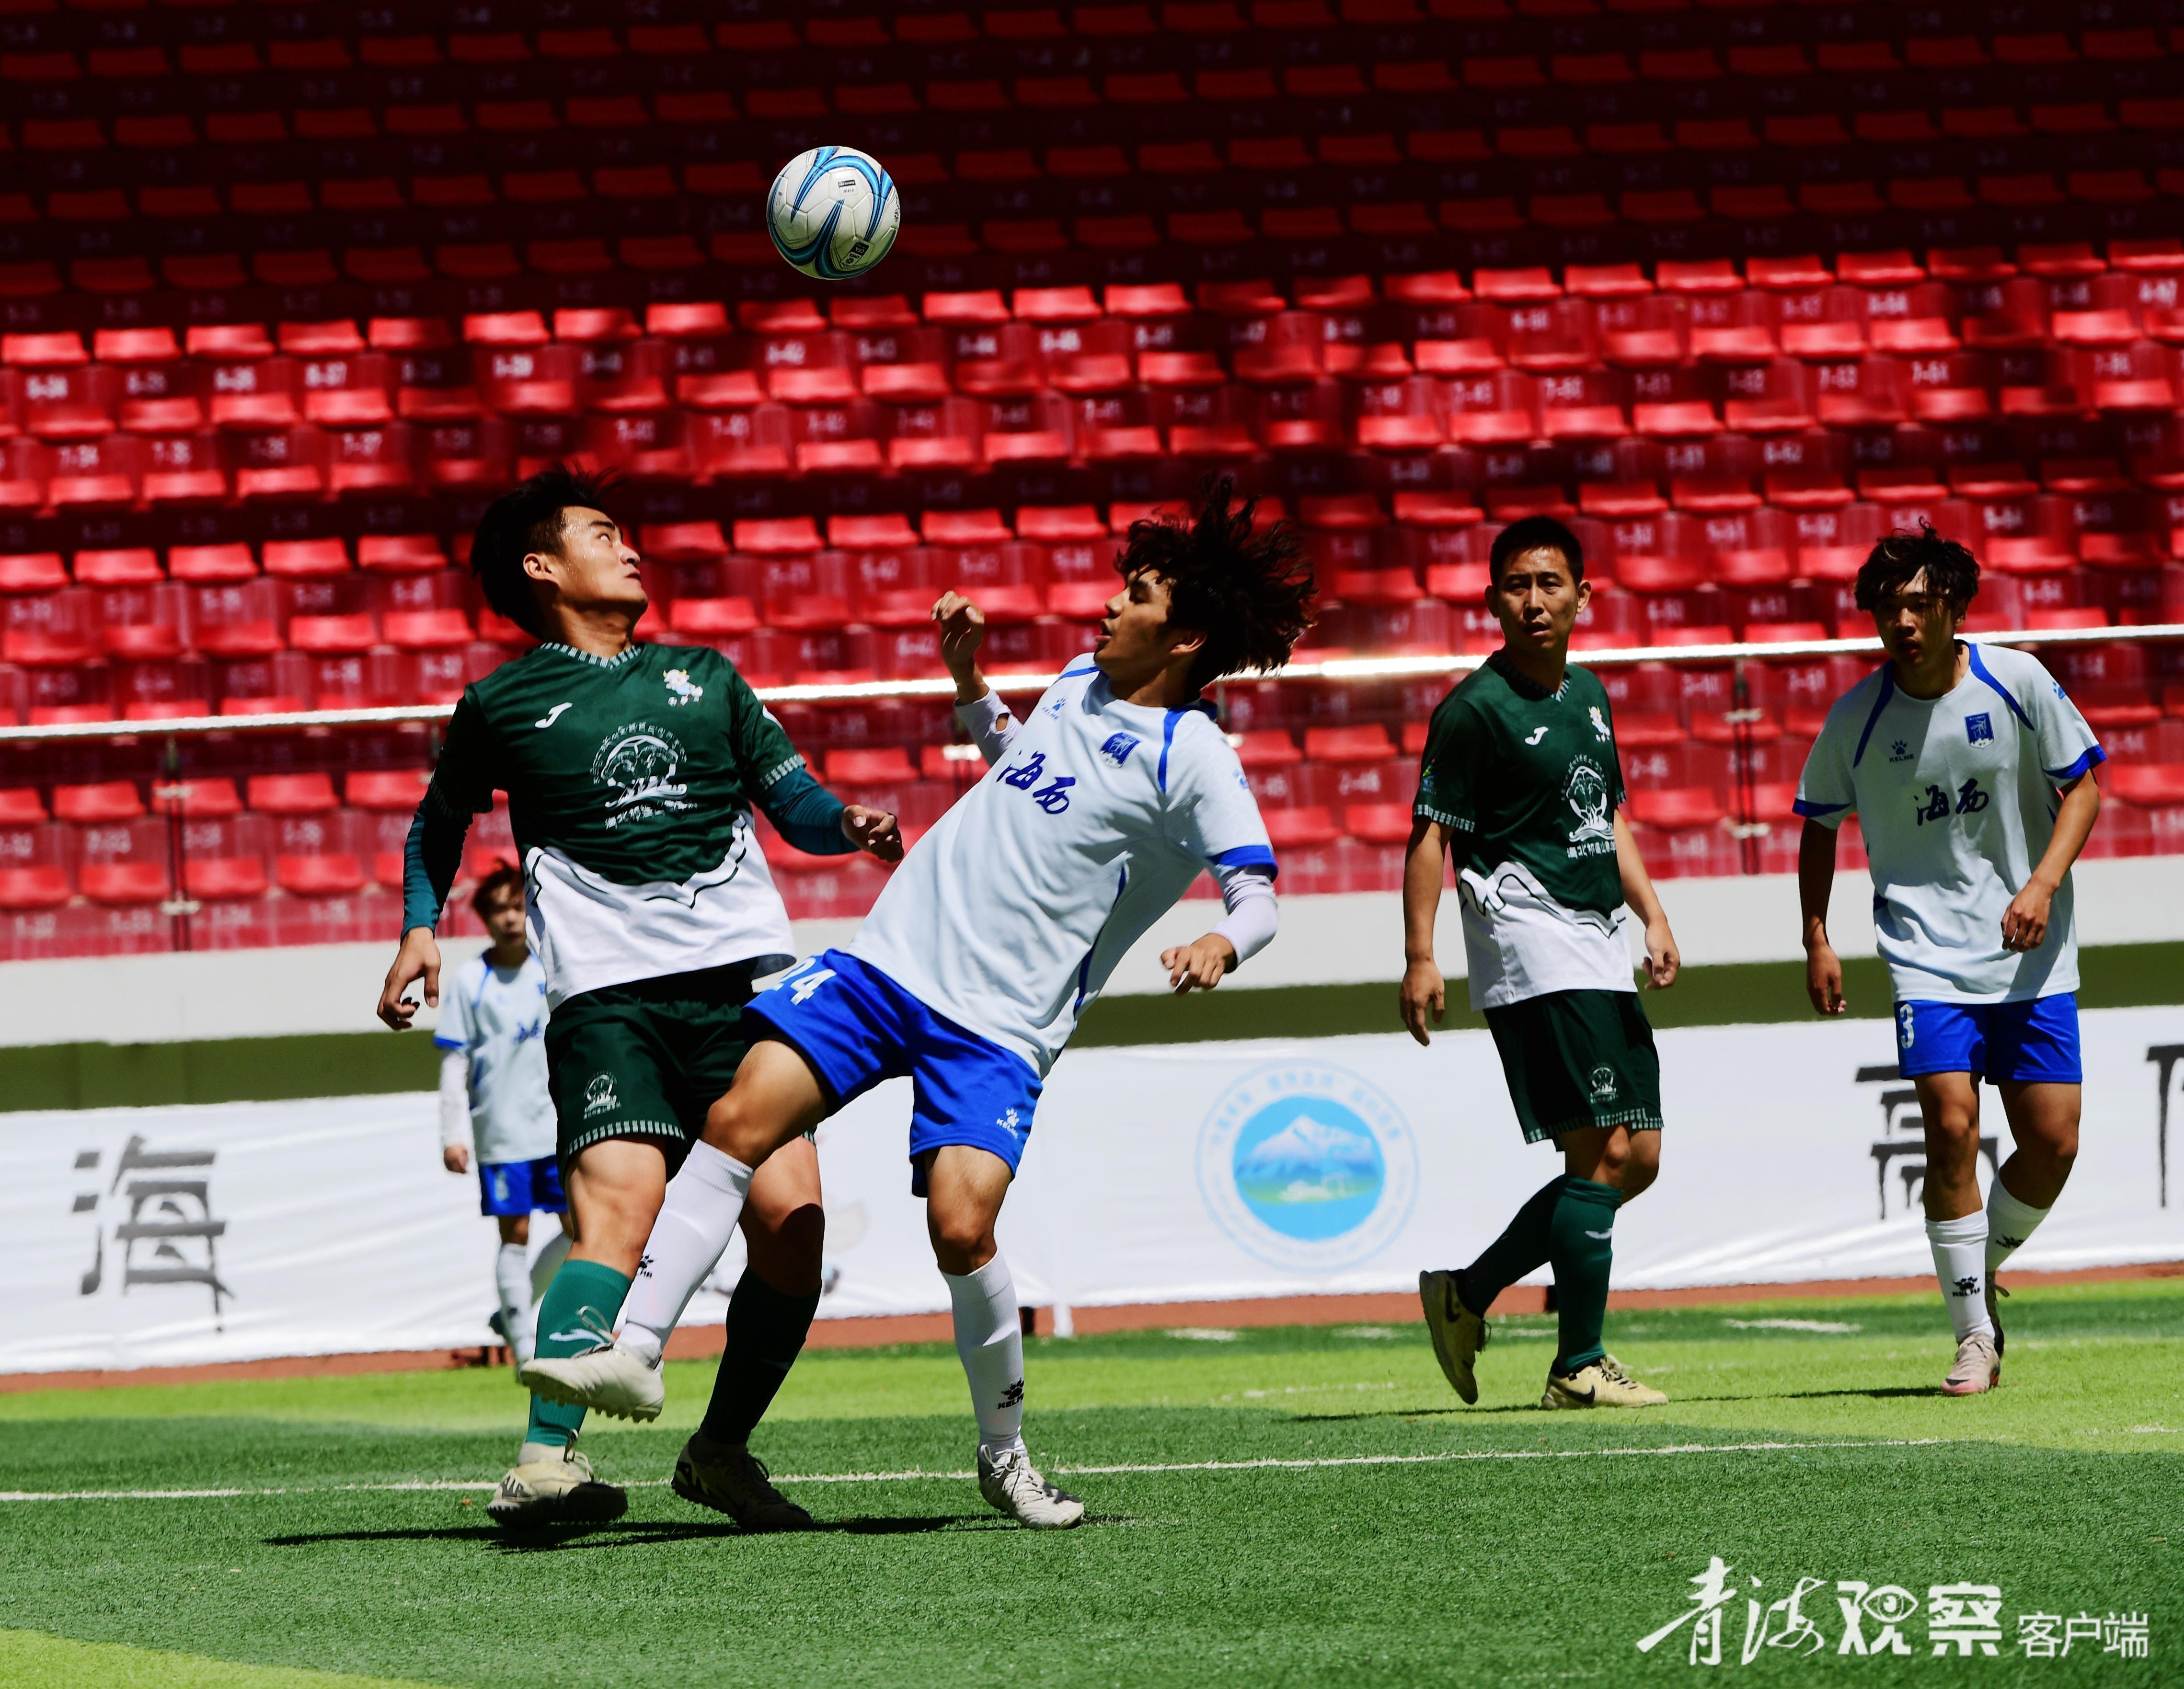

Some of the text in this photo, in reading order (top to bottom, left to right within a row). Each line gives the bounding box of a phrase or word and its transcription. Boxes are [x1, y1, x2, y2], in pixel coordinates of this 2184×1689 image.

[1889, 753, 1914, 762] KELME
[1913, 778, 1989, 827] 海西
[71, 1134, 237, 1333] 海
[997, 1392, 1024, 1410] KELM
